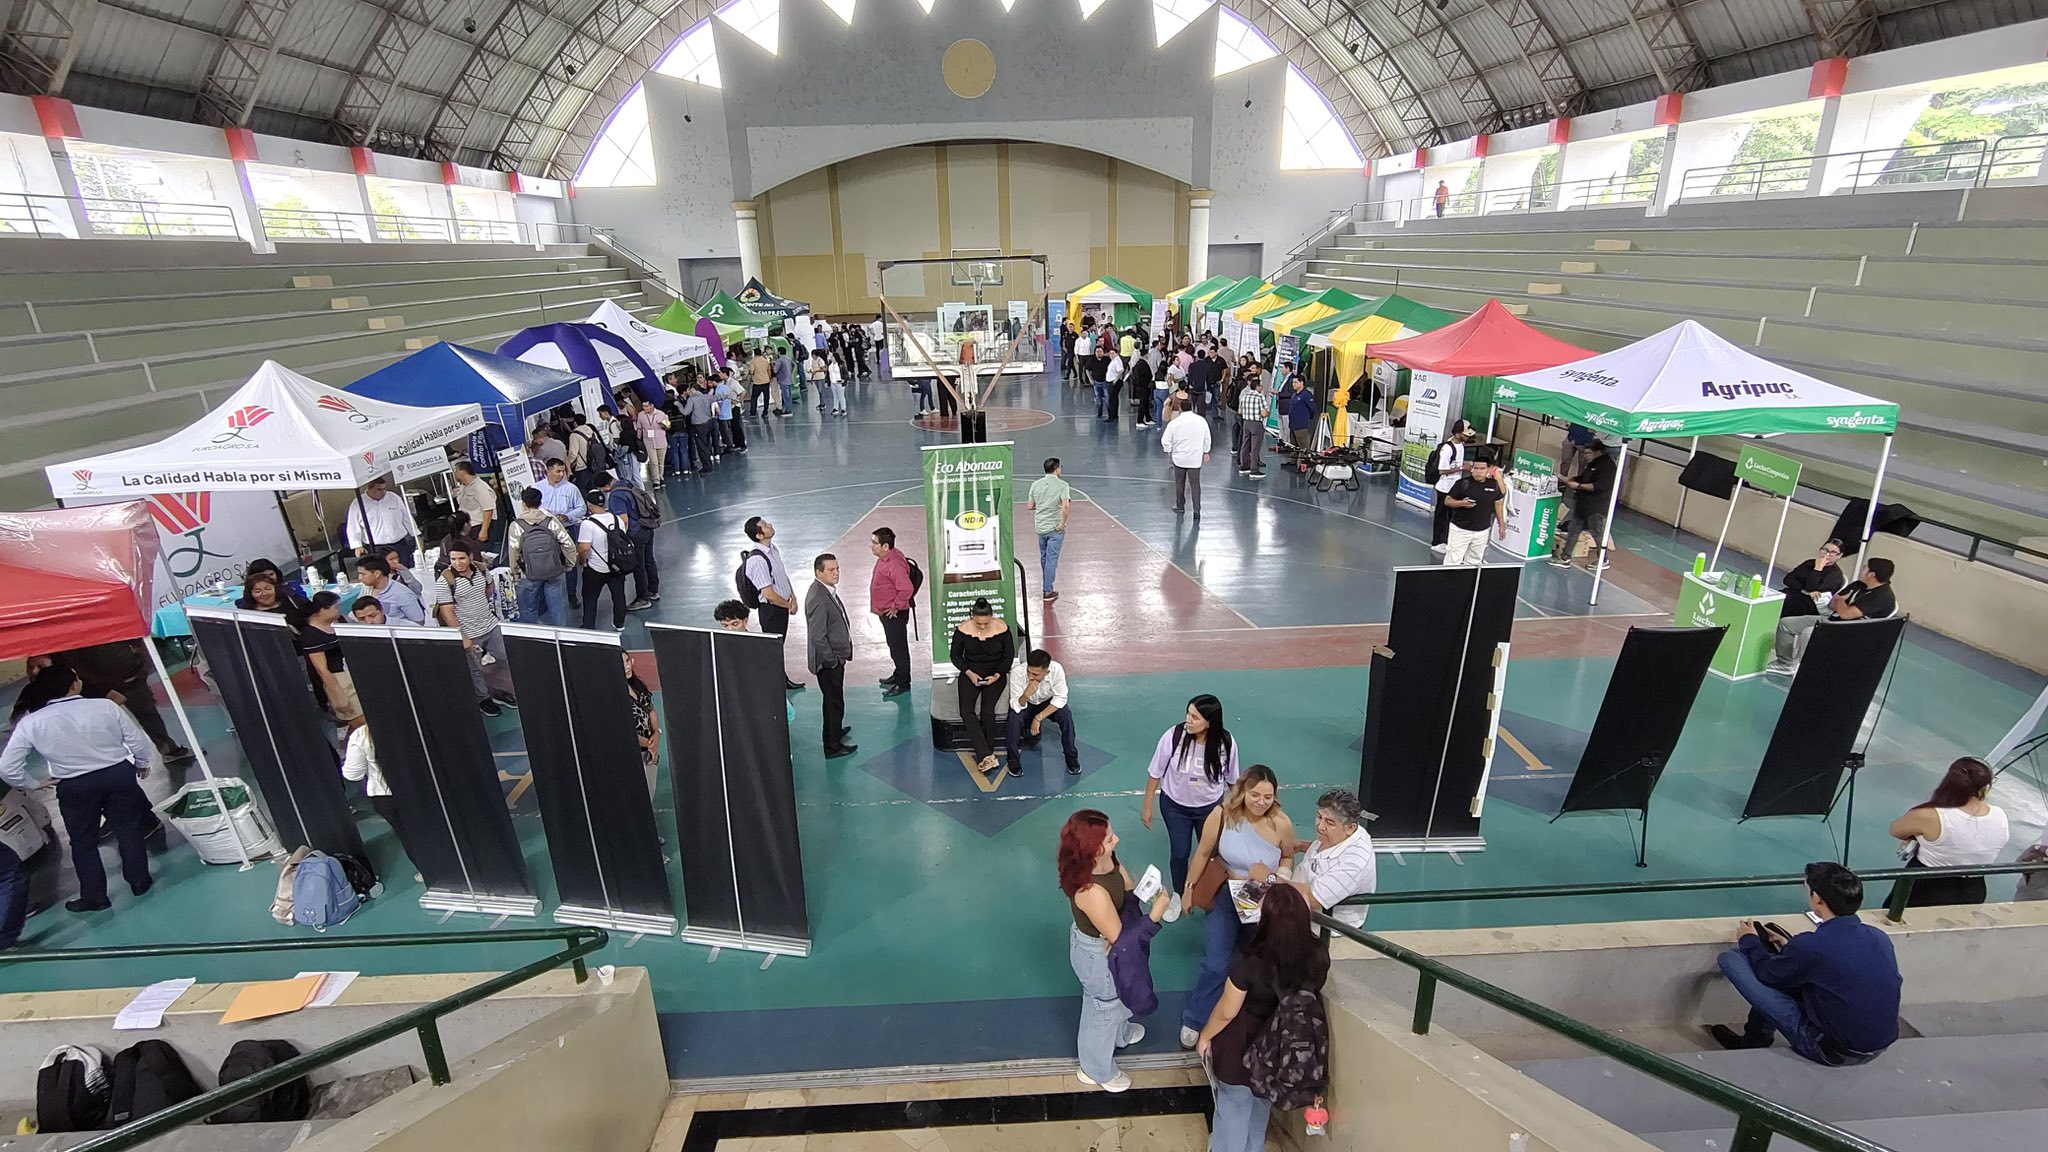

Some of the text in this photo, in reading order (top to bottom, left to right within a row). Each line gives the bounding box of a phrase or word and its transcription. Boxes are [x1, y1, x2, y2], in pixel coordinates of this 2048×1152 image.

[1559, 370, 1620, 388] syngenta
[1702, 380, 1794, 400] Agripac
[1584, 412, 1619, 428] syngenta
[1636, 417, 1686, 432] Agripac
[1826, 411, 1887, 428] syngenta
[387, 450, 400, 460] La
[397, 435, 426, 456] Calidad
[422, 429, 444, 443] Habla
[442, 424, 455, 438] por
[460, 414, 480, 428] Misma
[406, 457, 434, 470] EUROAGRO
[506, 463, 527, 475] ORGEVIT
[936, 460, 1003, 474] Eco Abonaza
[121, 469, 342, 487] La Calidad Habla por si Misma
[1535, 507, 1551, 547] Agripac
[1692, 611, 1716, 627] Lucha
